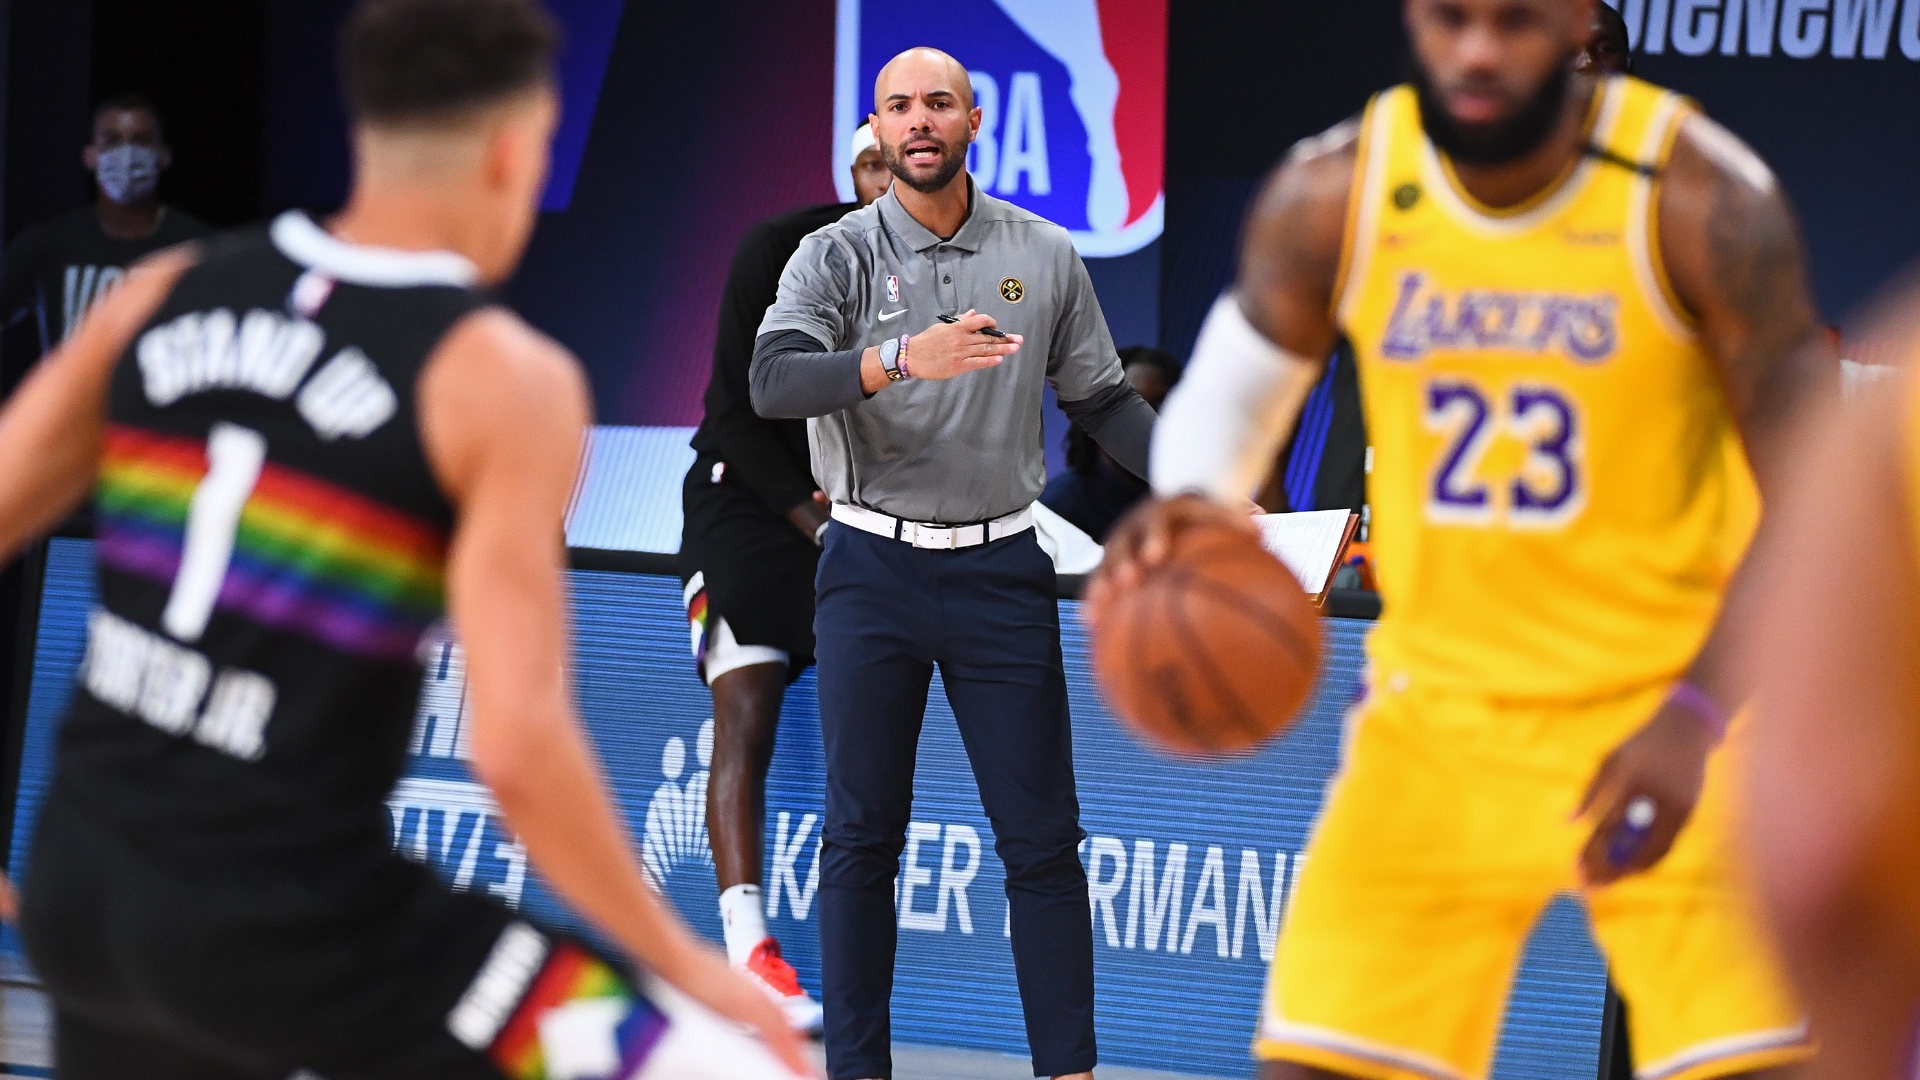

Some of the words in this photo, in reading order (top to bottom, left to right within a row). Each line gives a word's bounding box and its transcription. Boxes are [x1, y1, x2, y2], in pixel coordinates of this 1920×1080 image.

[964, 70, 1052, 196] BA
[1380, 270, 1619, 364] LAKERS
[1425, 380, 1584, 528] 23
[162, 421, 267, 641] 1
